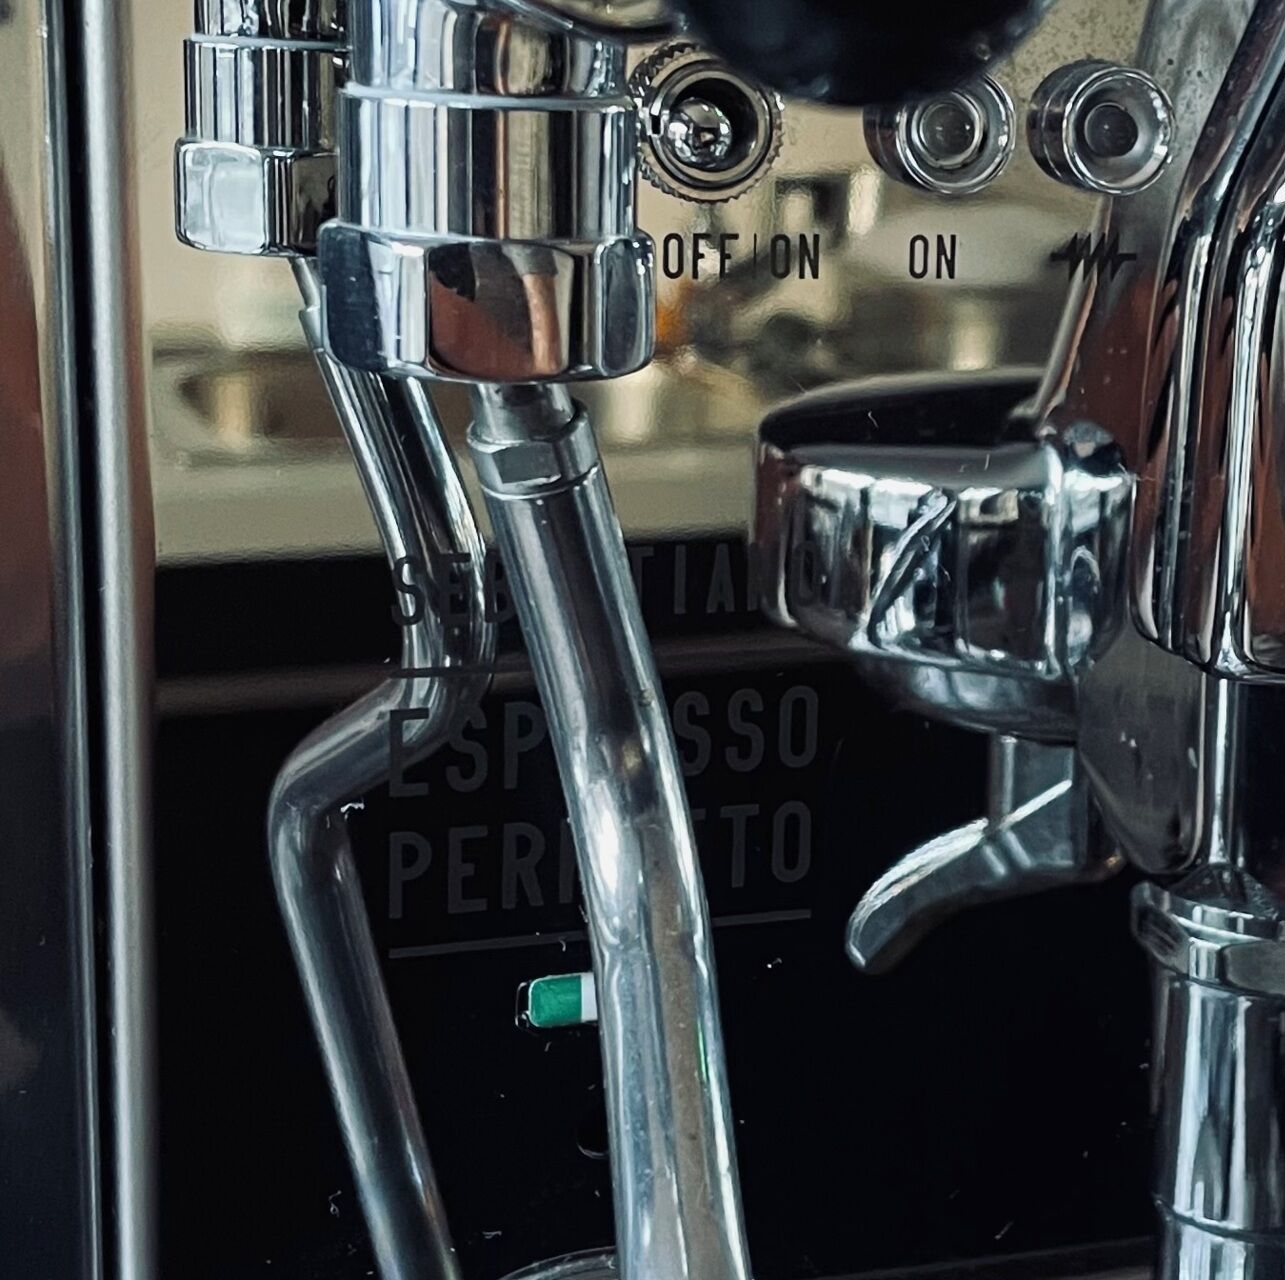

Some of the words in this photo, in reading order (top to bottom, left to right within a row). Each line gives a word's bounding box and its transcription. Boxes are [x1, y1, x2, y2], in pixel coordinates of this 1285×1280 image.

[663, 233, 737, 279] OFF
[771, 233, 820, 279] ON
[909, 234, 956, 279] ON
[391, 541, 819, 626] SEBTIANO
[388, 685, 819, 797] ESPSSO
